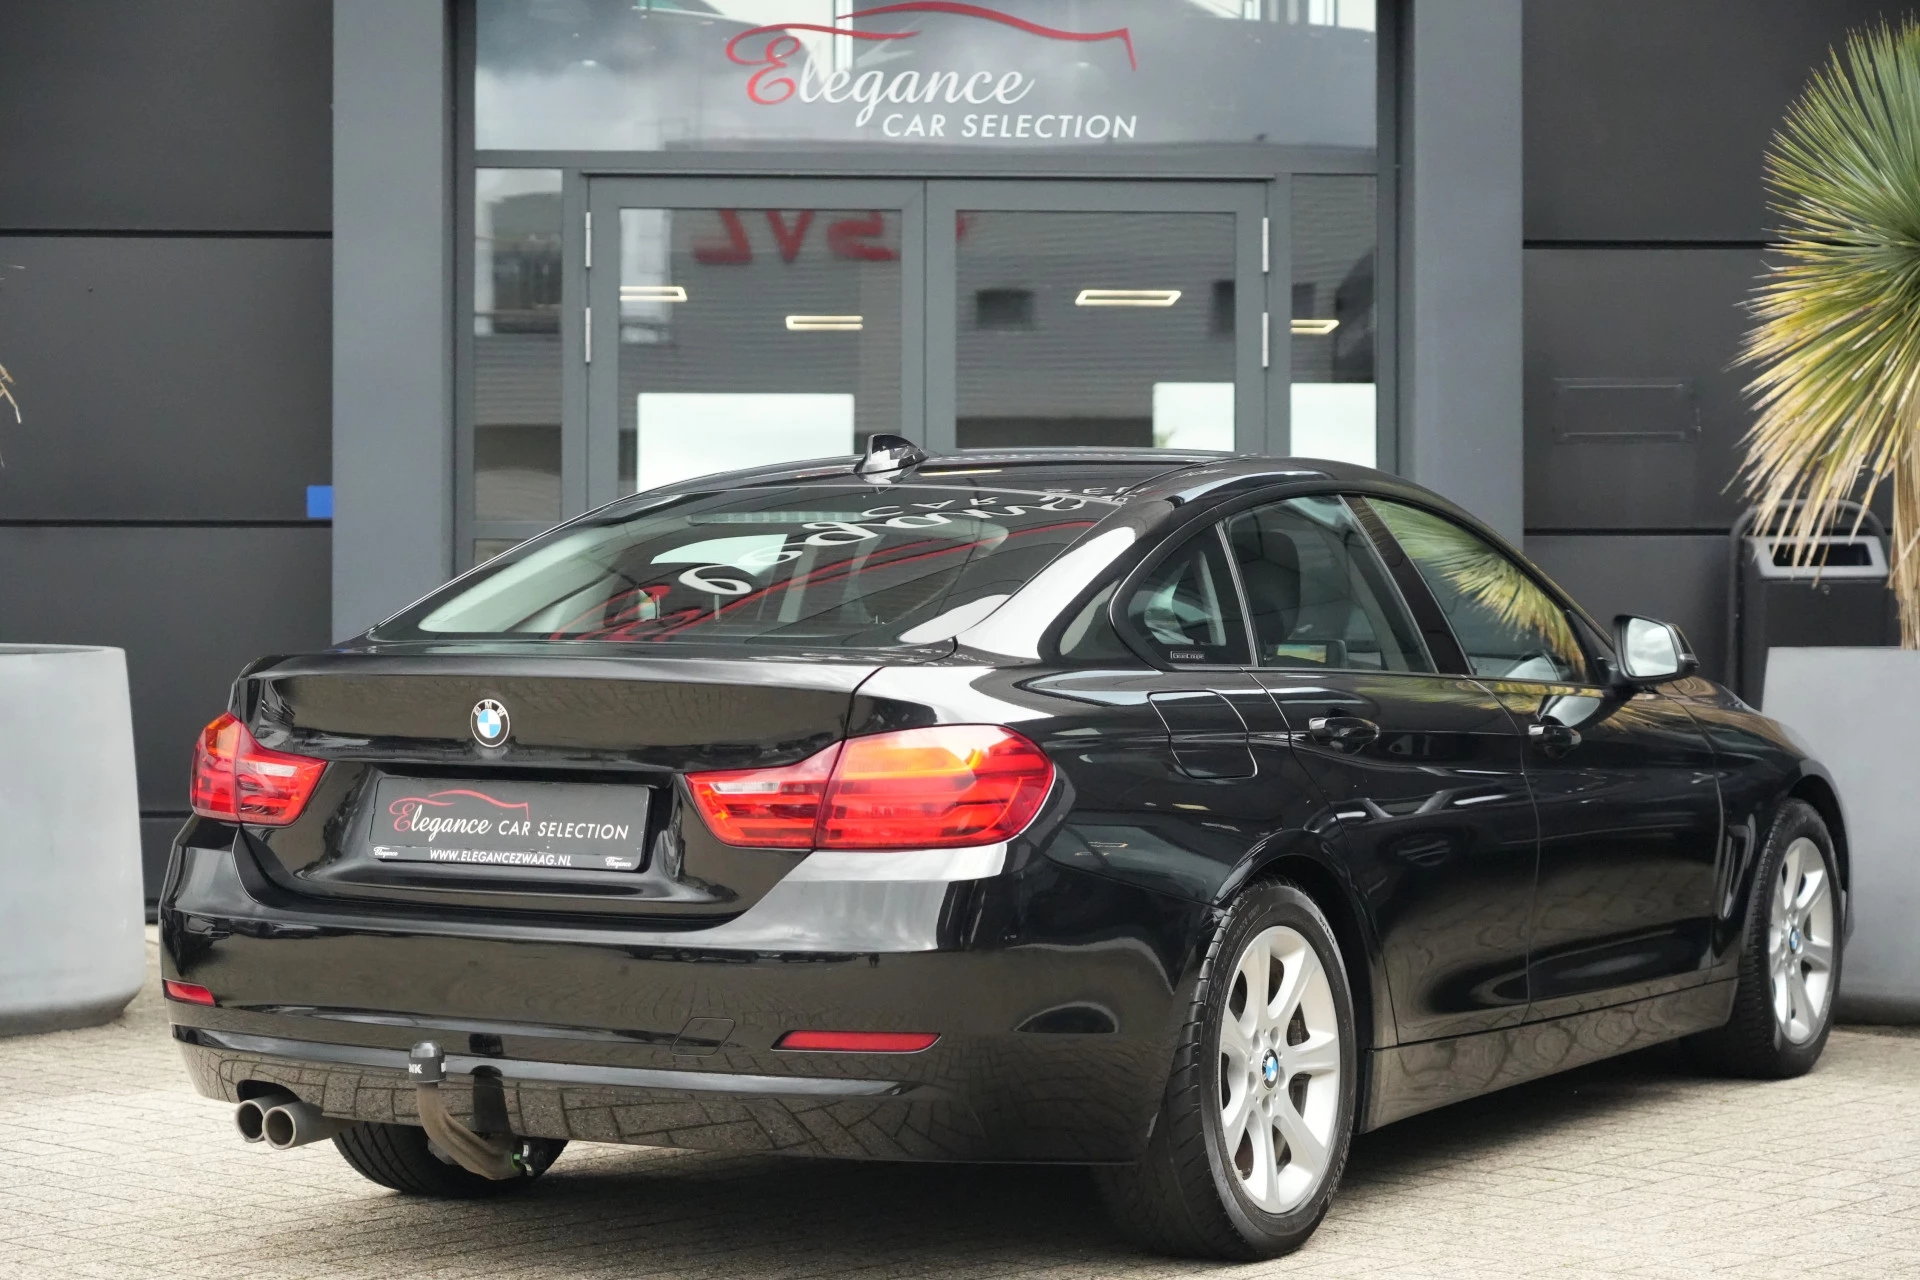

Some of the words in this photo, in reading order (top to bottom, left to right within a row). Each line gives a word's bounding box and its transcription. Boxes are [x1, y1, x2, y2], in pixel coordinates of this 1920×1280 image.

[726, 24, 1035, 128] Elegance
[882, 114, 945, 138] CAR
[961, 114, 1137, 139] SELECTION
[389, 797, 493, 842] Elegance
[498, 820, 531, 836] CAR
[538, 821, 629, 840] SELECTION
[429, 849, 572, 867] WWW.ELEGANCEZWAAG.NL
